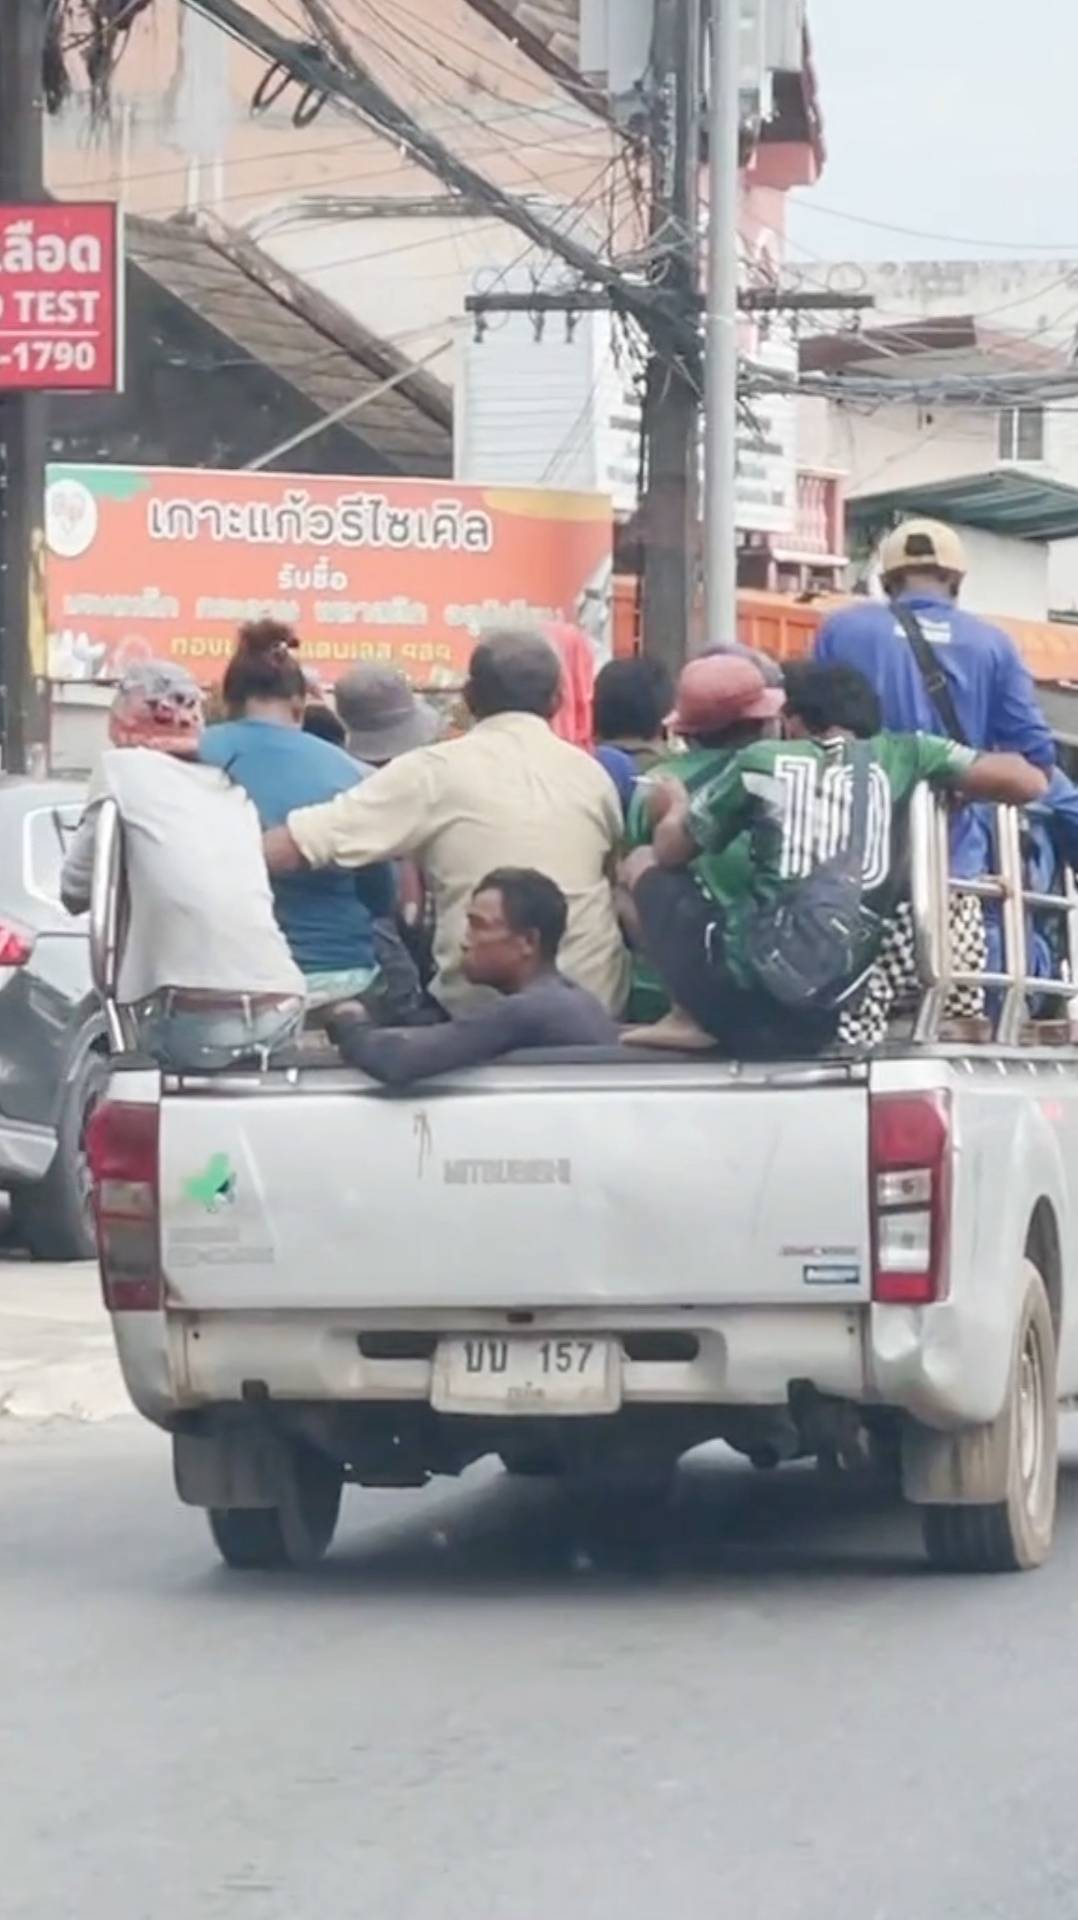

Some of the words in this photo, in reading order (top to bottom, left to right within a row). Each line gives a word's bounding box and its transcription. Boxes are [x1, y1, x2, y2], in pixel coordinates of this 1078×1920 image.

[0, 219, 101, 273] ลือด
[13, 290, 101, 323] TEST
[148, 490, 491, 550] เกาะแก้วรีไซเคิล
[278, 555, 348, 590] รับซื้อ
[774, 753, 892, 891] 10
[540, 1342, 594, 1373] 157
